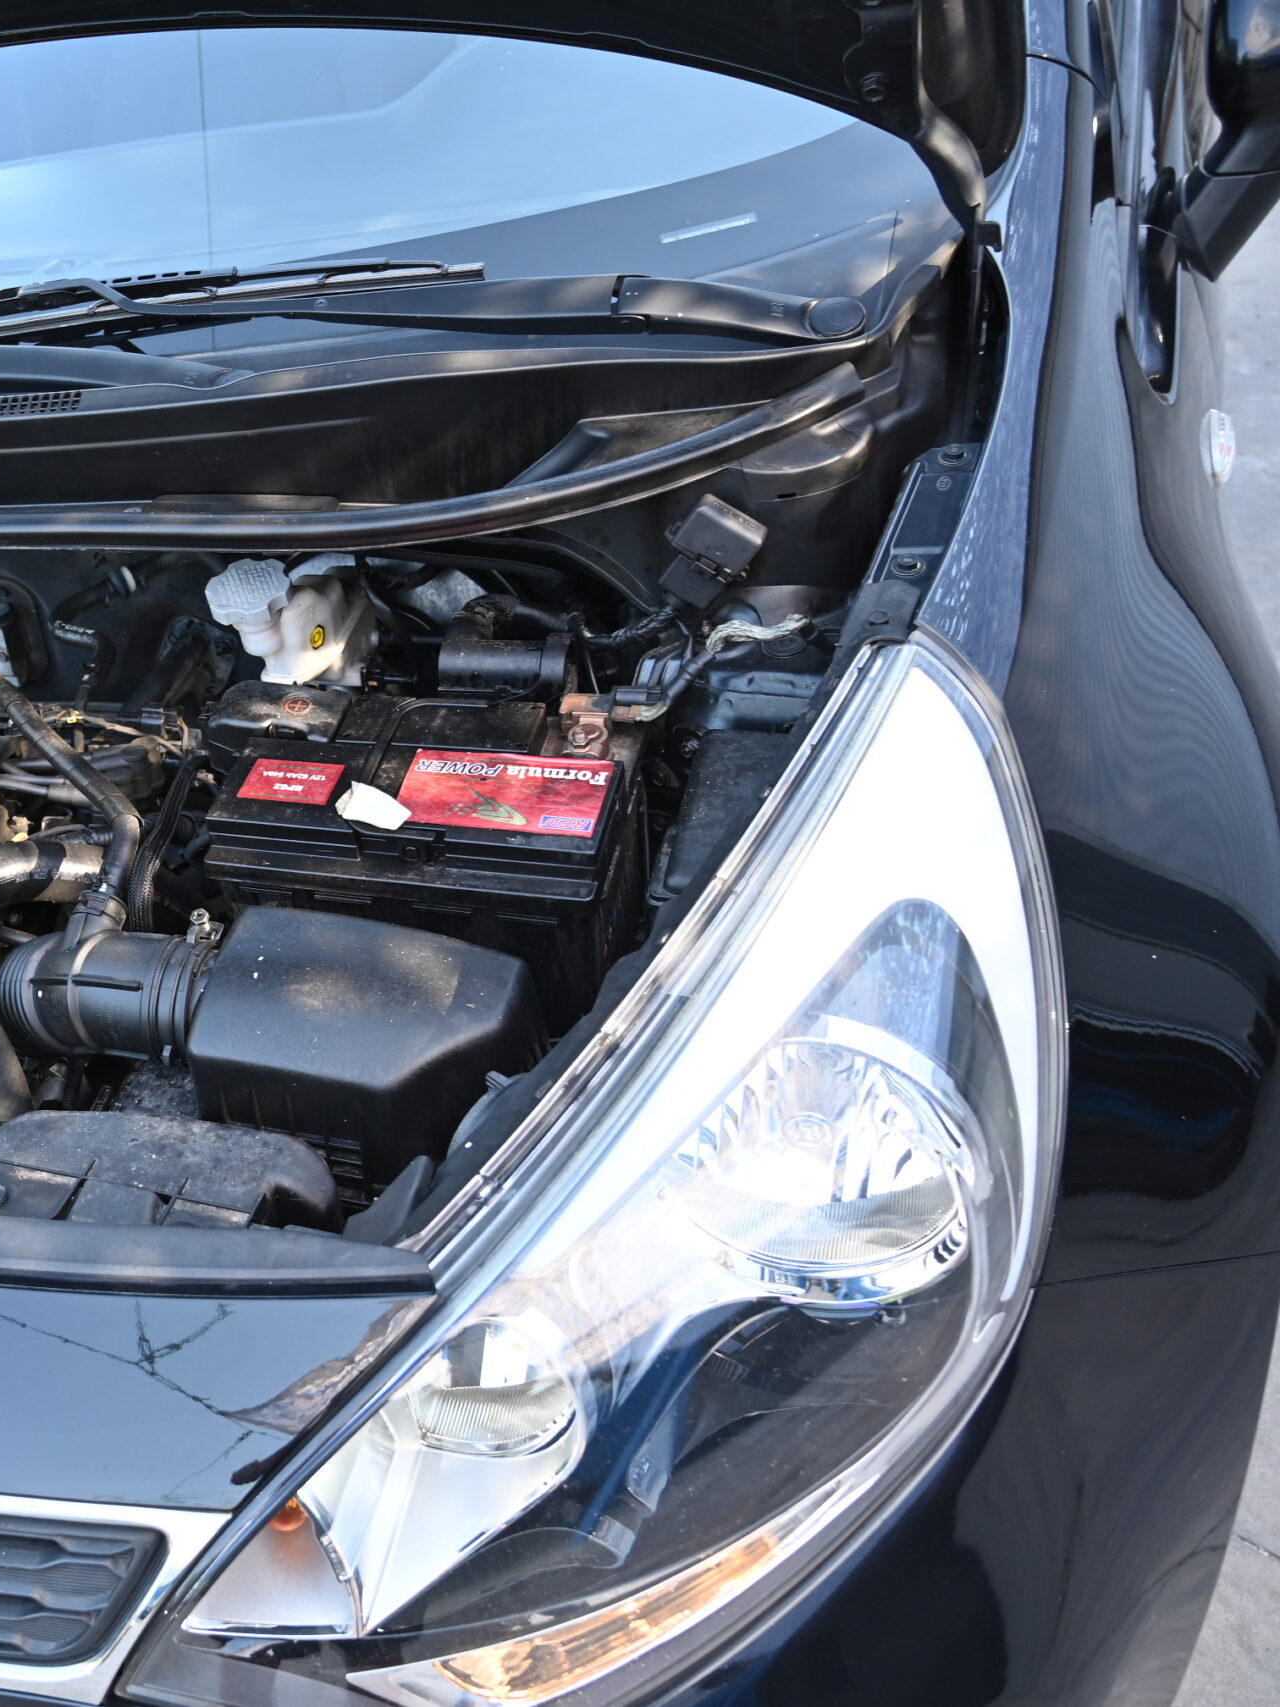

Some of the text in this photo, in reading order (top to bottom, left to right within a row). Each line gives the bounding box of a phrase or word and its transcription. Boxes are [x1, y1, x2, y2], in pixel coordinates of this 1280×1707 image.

[415, 760, 609, 785] Formula POWER
[546, 818, 588, 830] RED
